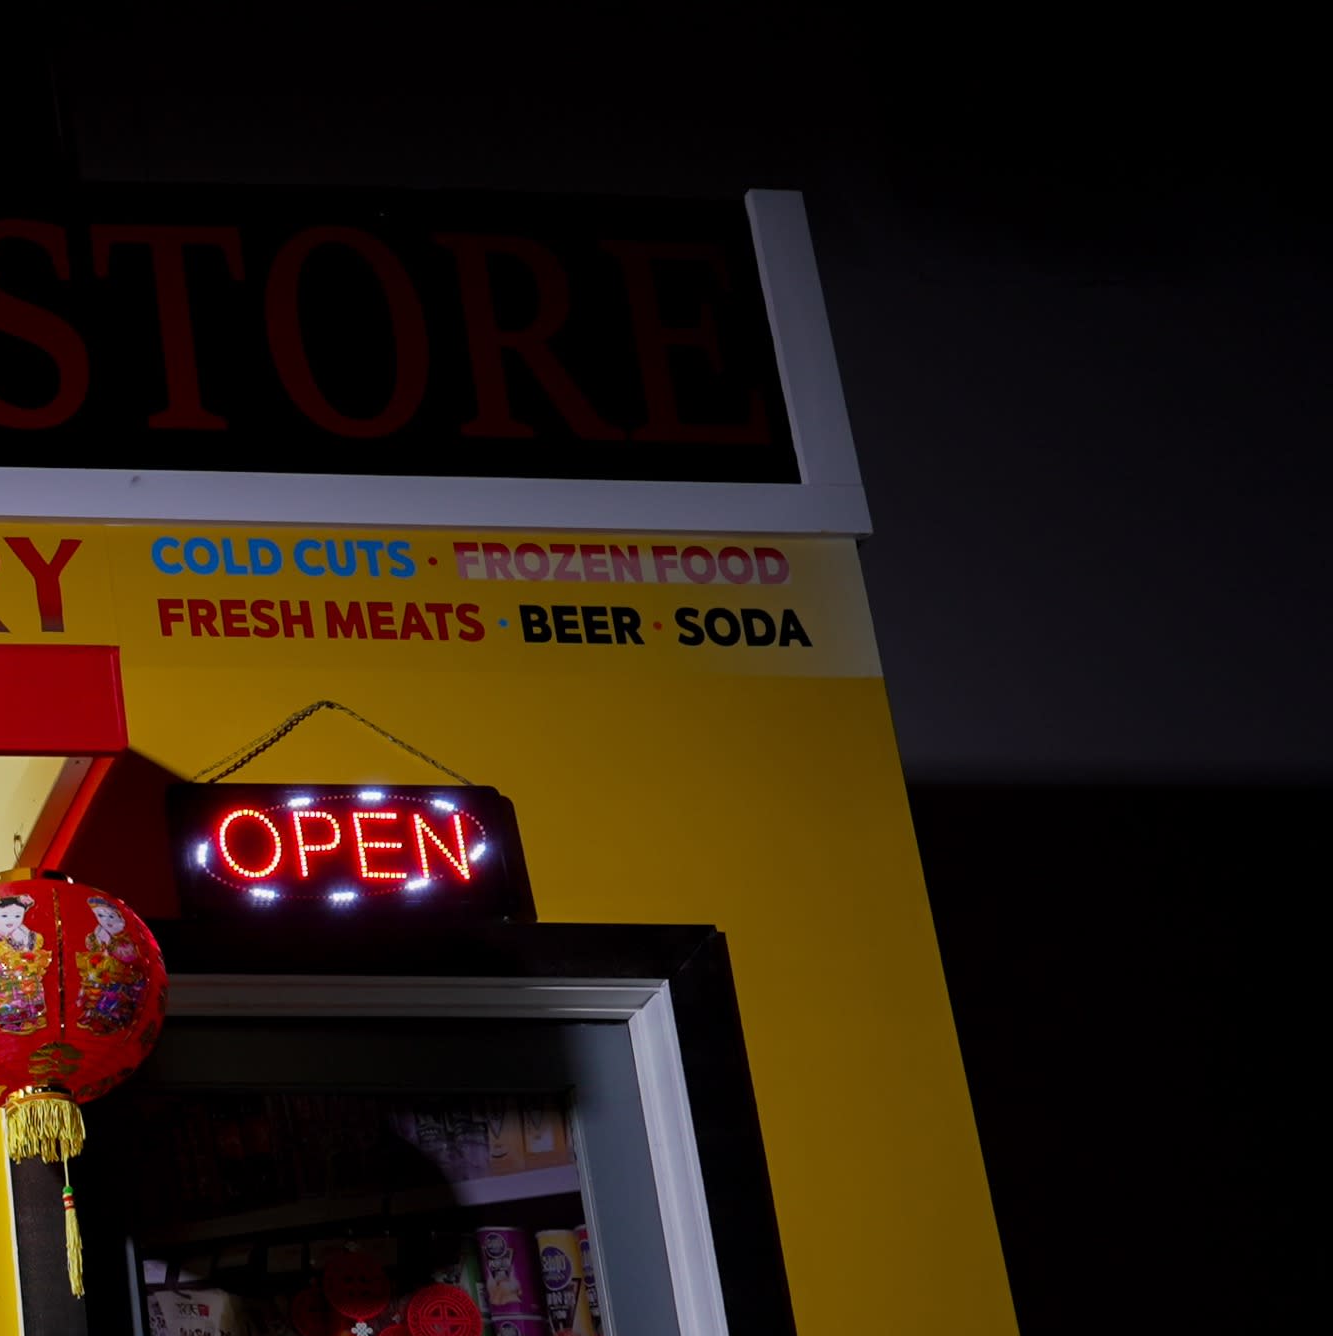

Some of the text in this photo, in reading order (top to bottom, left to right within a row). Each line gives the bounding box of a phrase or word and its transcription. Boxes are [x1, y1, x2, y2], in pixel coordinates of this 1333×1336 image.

[151, 537, 790, 584] COLD CUTS FROZEN FOOD
[158, 598, 812, 648] FRESH MEATS BEER SODA
[217, 809, 471, 880] OPEN
